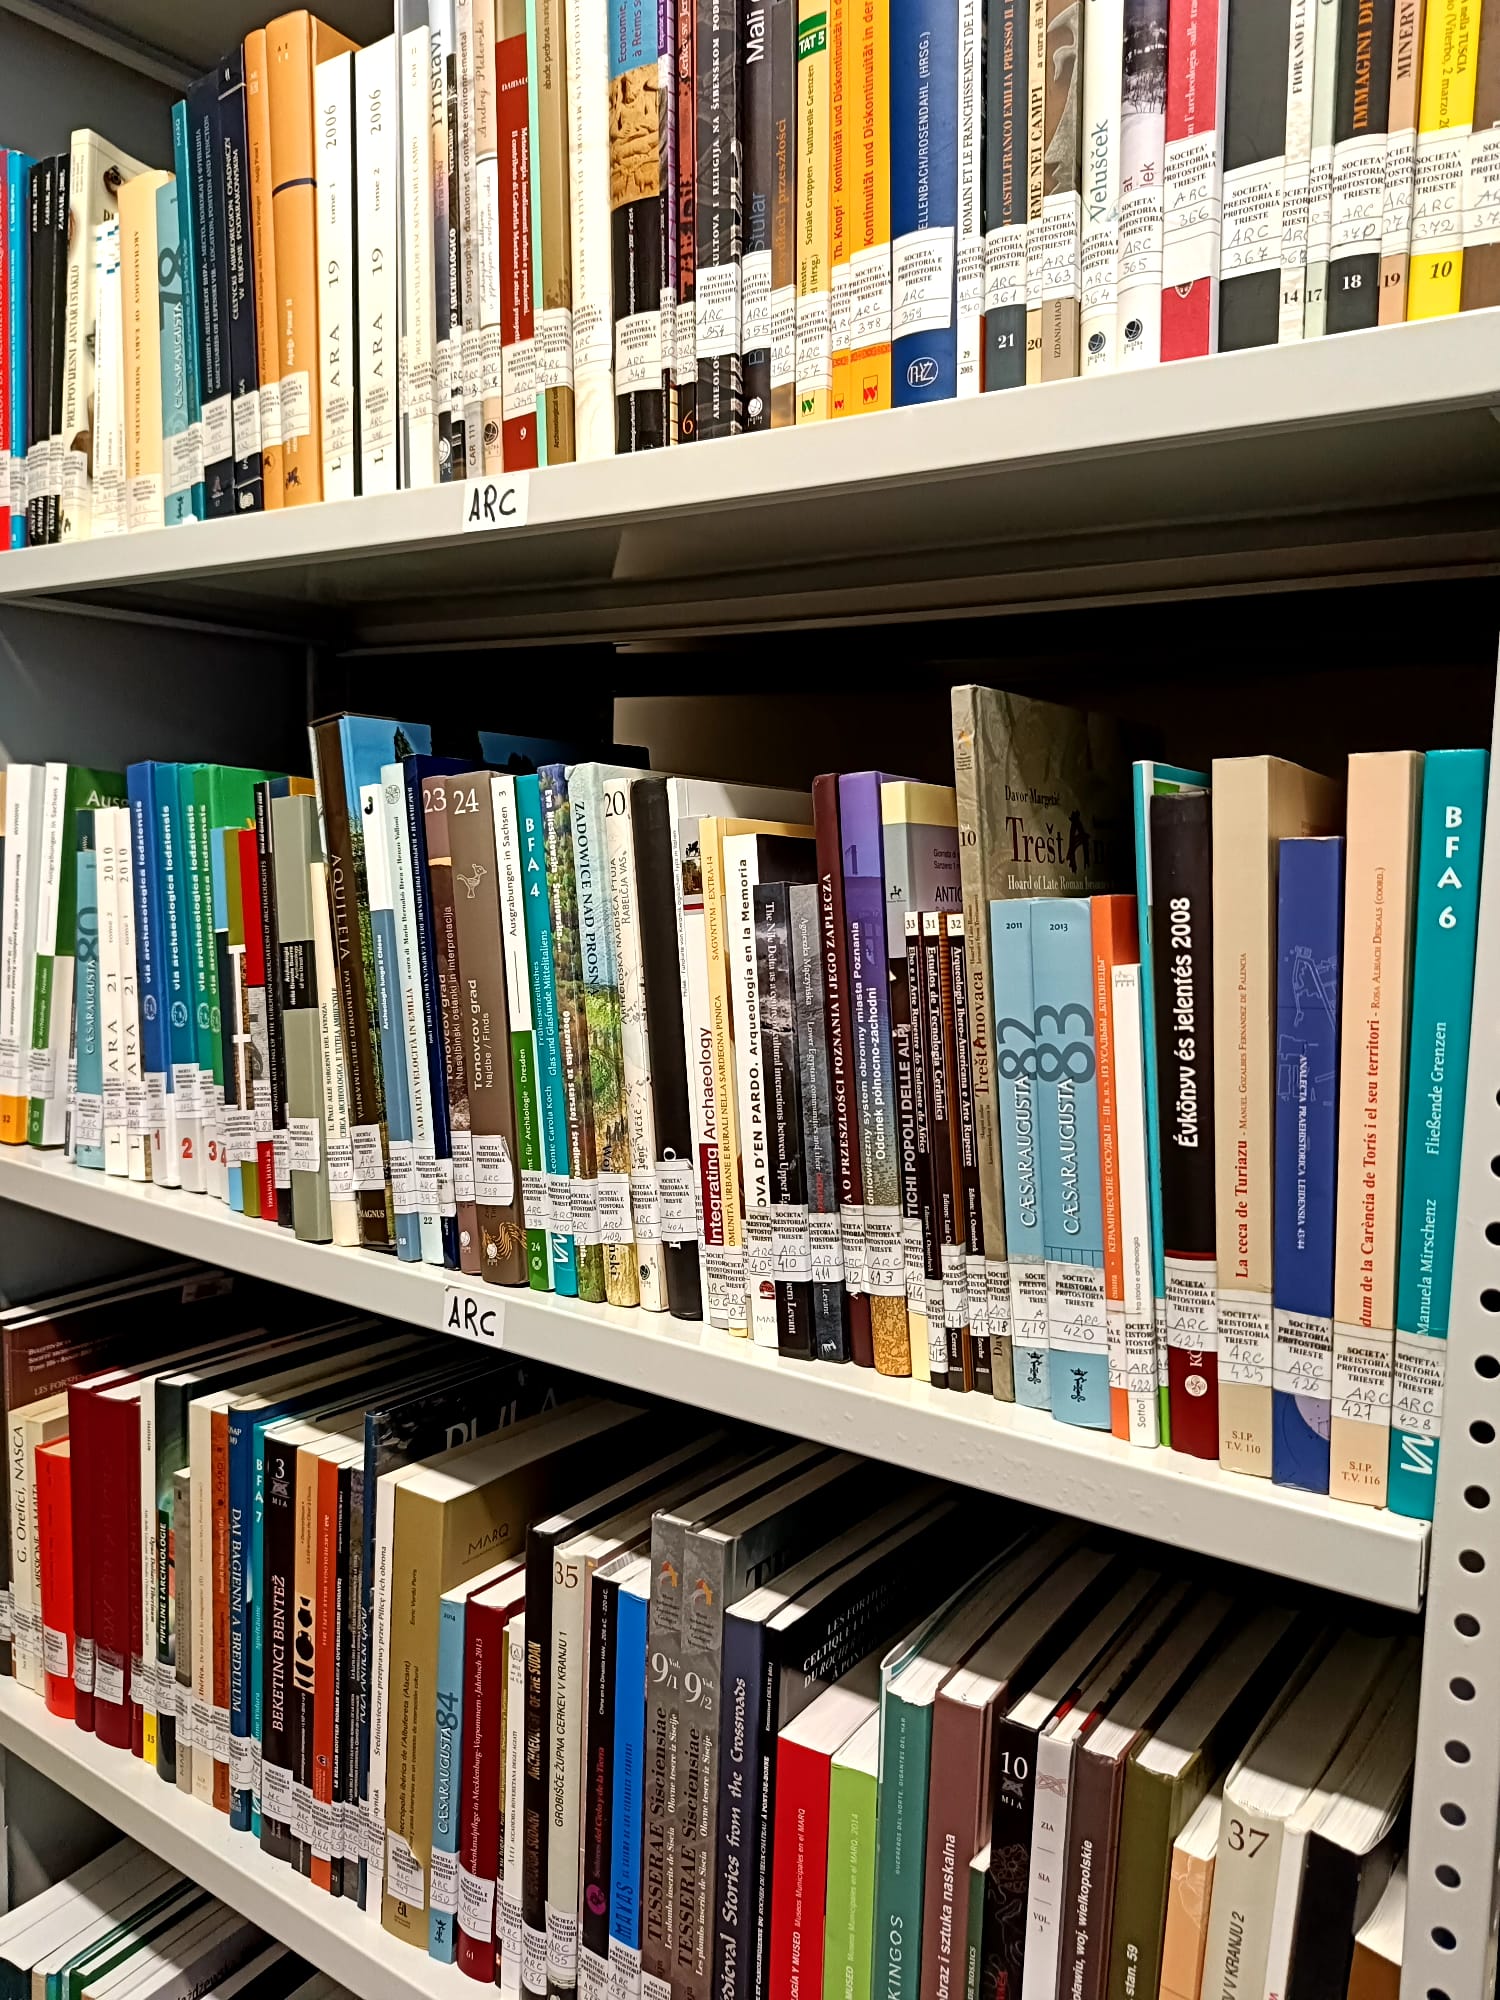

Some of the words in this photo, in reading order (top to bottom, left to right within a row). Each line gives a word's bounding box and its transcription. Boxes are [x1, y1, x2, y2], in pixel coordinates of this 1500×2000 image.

[864, 1, 874, 23] der
[964, 1, 974, 18] LA
[964, 21, 974, 36] DE
[746, 8, 765, 64] Mali
[799, 36, 816, 54] TAT
[817, 30, 825, 45] 5
[864, 26, 873, 39] in
[918, 31, 931, 78] (HRSG.)
[1004, 21, 1014, 70] PRESSO
[459, 31, 469, 120] environnemental
[710, 37, 720, 110] ŠIBENSKOM
[834, 22, 843, 102] Diskontinuität
[1353, 31, 1373, 129] IMMAGINI
[806, 64, 815, 106] Grenzen
[863, 42, 874, 138] Diskontinuität
[964, 40, 974, 148] FRANCHISSEMENT
[1003, 73, 1013, 118] EMILIA
[324, 104, 337, 150] 2006
[369, 89, 382, 135] 2006
[712, 116, 720, 133] NA
[806, 108, 814, 155] kulturelle
[834, 104, 842, 126] und
[1031, 85, 1043, 142] CAMPI
[462, 122, 470, 166] contexte
[834, 129, 844, 192] Kontinuität
[864, 142, 874, 167] und
[964, 150, 973, 164] LE
[1030, 147, 1042, 177] NEI
[464, 172, 470, 182] et
[712, 140, 721, 196] RELIGIJA
[805, 165, 815, 208] Gruppen
[964, 168, 973, 183] ET
[1003, 121, 1012, 217] CASTELFRANCO
[1090, 118, 1109, 222] Velušček
[863, 170, 875, 246] Kontinuität
[964, 186, 973, 233] ROMAIN
[1172, 185, 1208, 208] ARC
[804, 210, 813, 245] Soziale
[834, 204, 845, 239] Knopf
[1227, 224, 1270, 248] ARC
[371, 247, 384, 277] 19
[834, 241, 843, 260] Th.
[1429, 260, 1453, 280] 10
[328, 260, 340, 288] 19
[1342, 274, 1363, 290] 18
[1383, 272, 1401, 289] 19
[998, 333, 1017, 350] 21
[477, 491, 532, 535] ARC
[454, 787, 480, 816] 24
[603, 790, 626, 818] 20
[500, 806, 511, 847] Sachsen
[103, 847, 114, 881] 2010
[118, 848, 128, 882] 2010
[503, 850, 510, 860] in
[574, 801, 592, 889] ZADOWICE
[583, 893, 594, 928] NAD
[331, 854, 350, 960] AQUILEIA
[504, 864, 518, 937] Ausgrabungen
[737, 858, 751, 922] Memoria
[822, 873, 836, 948] ZAPLECZA
[166, 874, 180, 967] archaeologica
[742, 927, 751, 940] la
[1006, 922, 1023, 930] 2011
[1049, 923, 1068, 932] 2013
[1170, 897, 1192, 948] 2008
[1438, 906, 1457, 929] 6
[539, 930, 551, 989] Mittelitaliens
[744, 945, 752, 962] en
[826, 952, 838, 990] JEGO
[851, 922, 862, 979] Poznania
[107, 972, 117, 993] 21
[123, 975, 134, 996] 21
[144, 964, 152, 984] via
[172, 970, 181, 990] via
[198, 972, 206, 992] via
[1170, 954, 1195, 1034] jelentés
[406, 988, 415, 1022] EMILIA
[468, 980, 481, 1014] grad
[544, 991, 554, 1039] Glasfunde
[743, 968, 758, 1056] Arqueología
[409, 1024, 417, 1036] IN
[482, 1012, 491, 1041] Finds
[830, 1002, 844, 1074] POZNANIA
[867, 987, 884, 1105] północno-zachodni
[1034, 1002, 1096, 1084] 83
[1367, 1020, 1380, 1077] territori
[471, 1017, 483, 1090] Tonovcov
[484, 1052, 493, 1088] Najdbe
[997, 1017, 1037, 1081] 82
[1174, 1037, 1196, 1061] és
[1430, 1022, 1447, 1082] Grenzen
[544, 1085, 553, 1109] Koch
[698, 1027, 717, 1140] Archaeology
[749, 1062, 762, 1124] PARDO.
[901, 1061, 914, 1110] DELLE
[1368, 1081, 1378, 1104] seu
[547, 1111, 555, 1142] Carola
[1172, 1066, 1199, 1148] Évkönyv
[1426, 1086, 1442, 1155] Fließende
[181, 1136, 193, 1159] 2
[873, 1108, 886, 1161] Odcinek
[902, 1114, 916, 1170] POPOLI
[1014, 1074, 1039, 1228] CÆSARAUGUSTA
[1057, 1076, 1080, 1236] CÆSARAUGUSTA
[1362, 1132, 1377, 1168] Torís
[1235, 1140, 1248, 1196] Turiazu
[706, 1146, 723, 1244] Integrating
[1235, 1201, 1248, 1218] de
[1236, 1223, 1248, 1254] ceca
[1360, 1192, 1376, 1255] Carència
[1420, 1198, 1438, 1272] Mirschenz
[1235, 1259, 1249, 1278] La
[1174, 1316, 1210, 1331] ARC
[1415, 1275, 1433, 1336] Manuela
[457, 1307, 519, 1358] ARC
[1341, 1402, 1371, 1421] 427
[12, 1424, 26, 1480] NASCA
[15, 1487, 28, 1540] Orefici,
[272, 1574, 286, 1641] BENTEŽ
[475, 1637, 483, 1658] 2013
[528, 1640, 541, 1675] SUDAN
[556, 1639, 568, 1681] KRANJU
[272, 1644, 284, 1732] BEKETINCI
[474, 1660, 483, 1696] Jahrbuch
[436, 1691, 458, 1730] 84
[731, 1677, 746, 1763] Crossroads
[554, 1737, 566, 1772] ŽUPNA
[650, 1706, 667, 1818] Sisciensiae
[1001, 1752, 1029, 1780] 10
[437, 1726, 452, 1834] CÆSARAUGUSTA
[554, 1774, 565, 1828] GROBIŠČE
[682, 1728, 700, 1841] Sisciensiae
[728, 1772, 743, 1798] the
[727, 1806, 742, 1848] from
[1227, 1818, 1270, 1858] 37
[648, 1822, 664, 1942] TESSERAE
[791, 1931, 801, 1966] MUSEO
[798, 1808, 806, 1832] MARQ
[942, 1833, 956, 1902] naskalna
[1076, 1839, 1093, 1926] wielkopolskie
[677, 1844, 696, 1968] TESSERAE
[721, 1855, 741, 1926] Stories
[940, 1904, 953, 1955] sztuka
[1231, 1910, 1245, 1924] 2
[1126, 1943, 1138, 1962] 59
[1224, 1922, 1244, 1978] KRANJU
[1125, 1964, 1137, 1996] stan.
